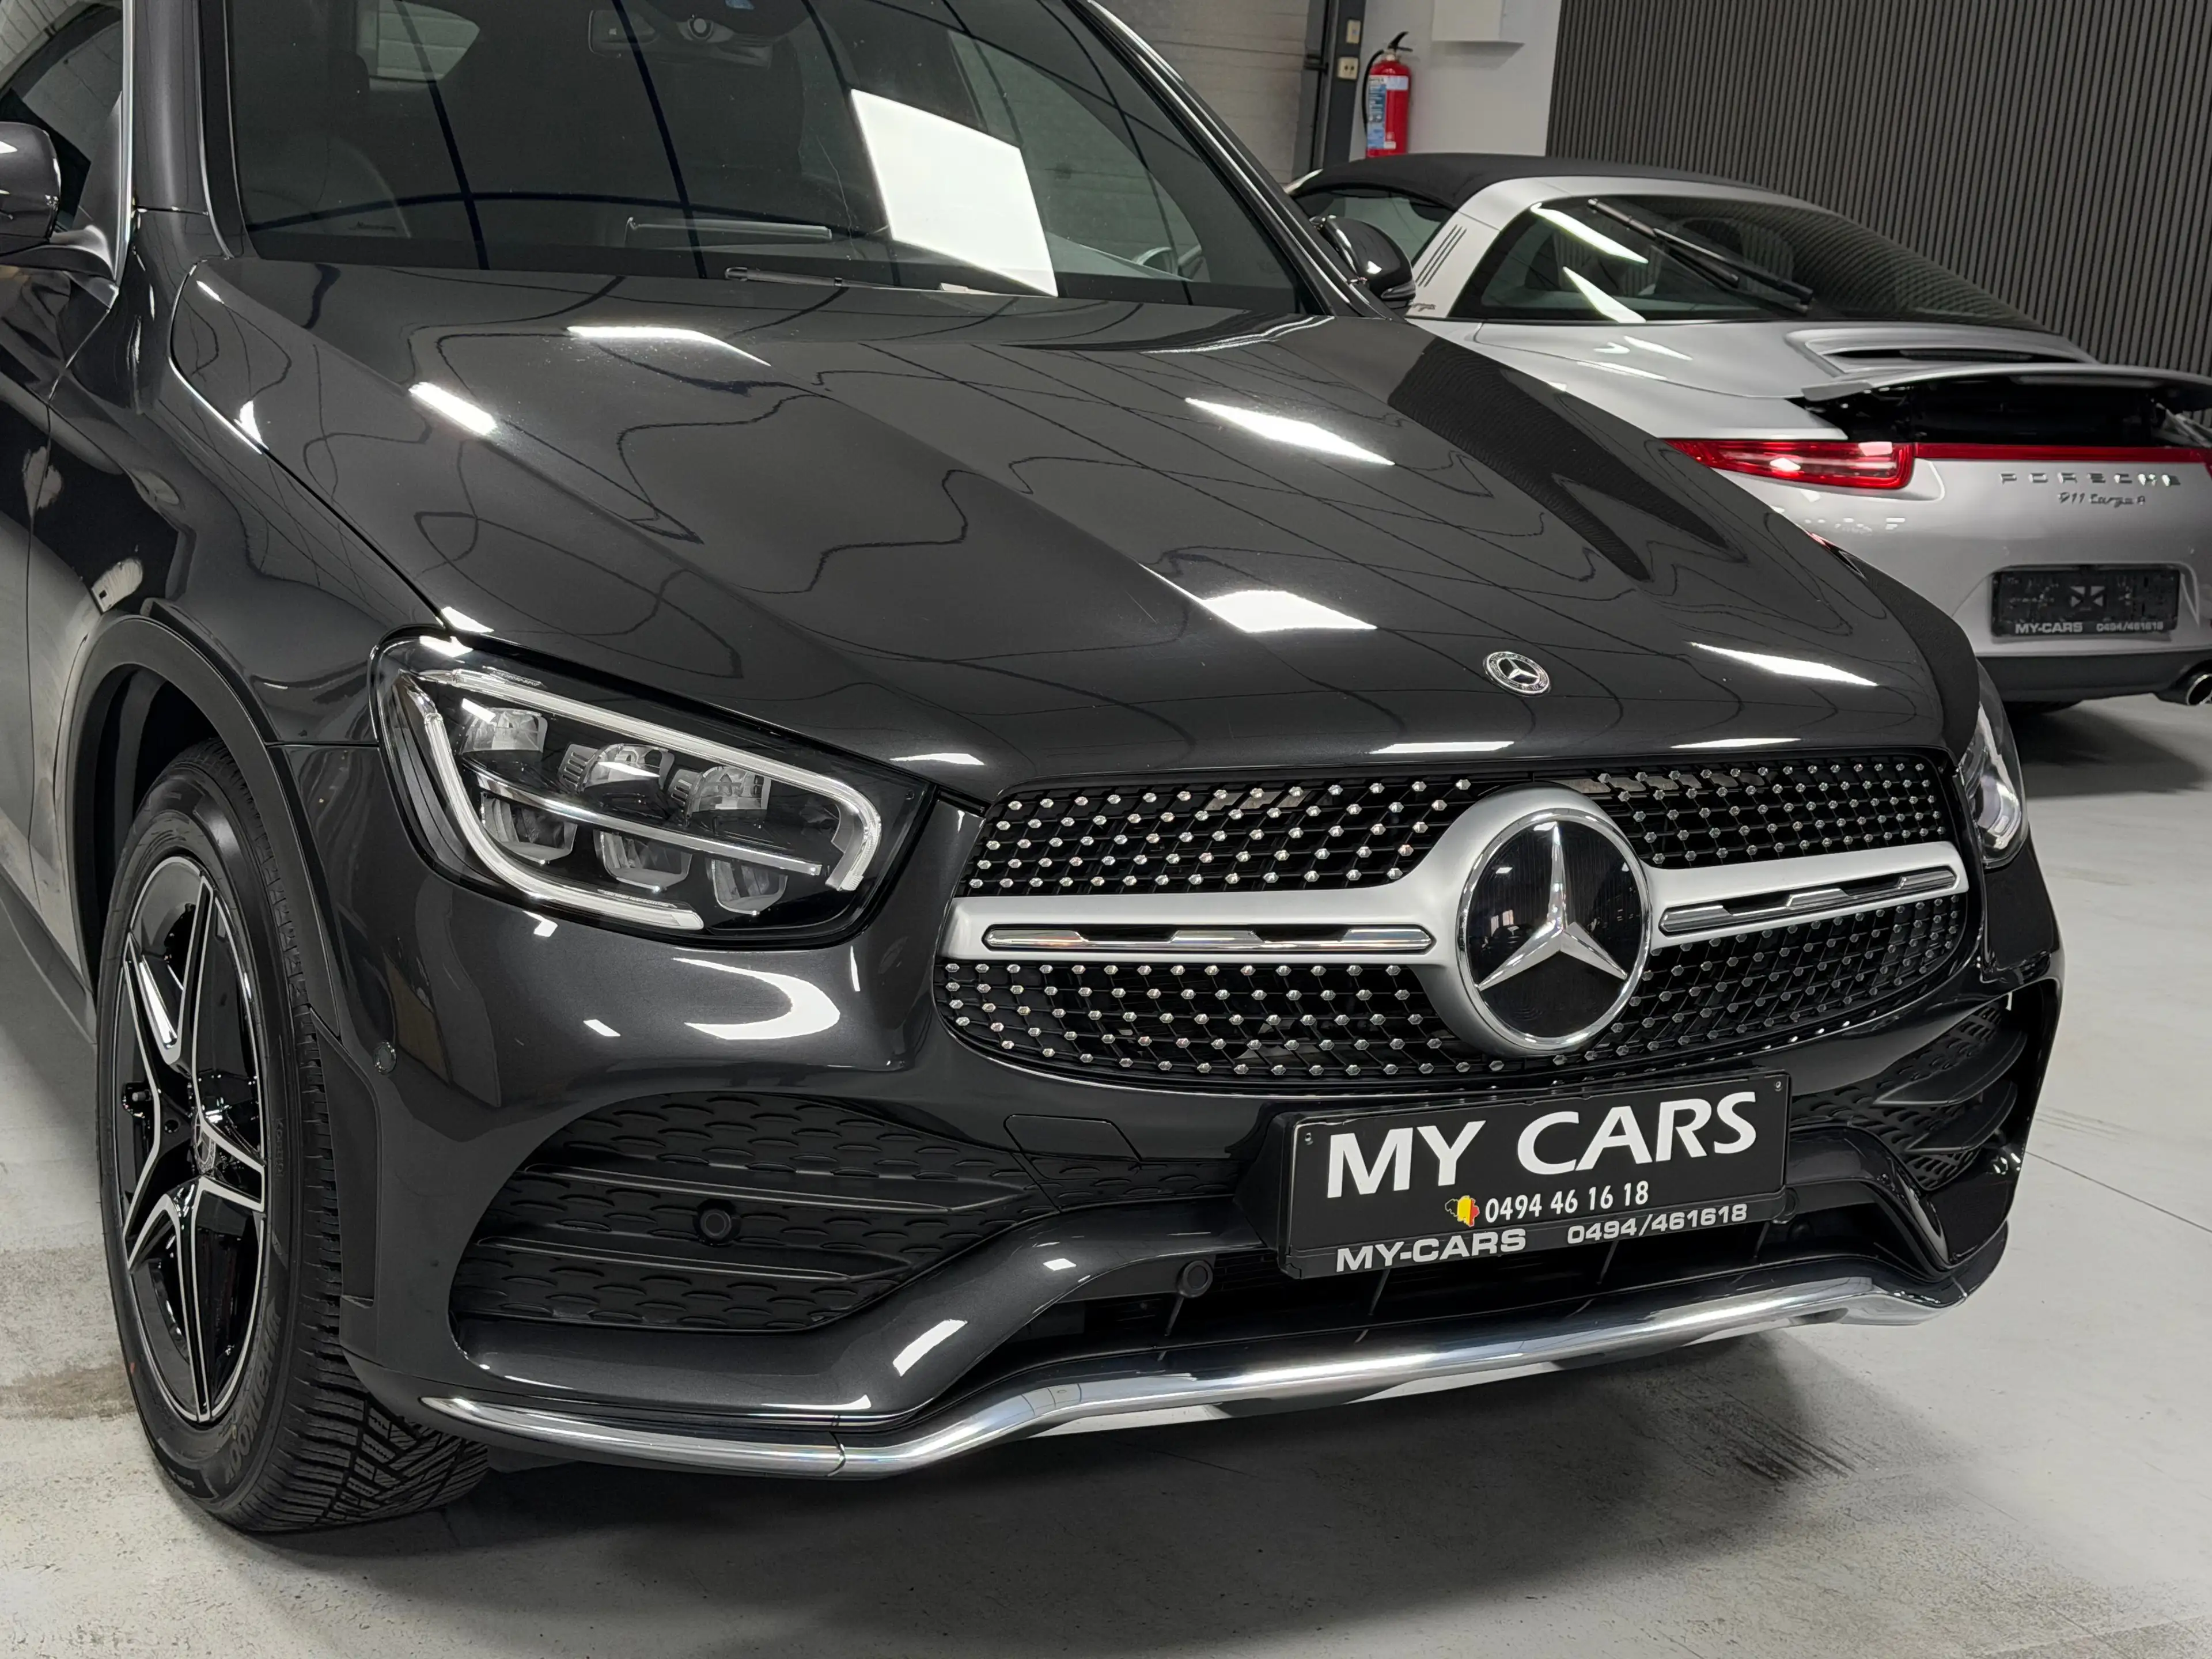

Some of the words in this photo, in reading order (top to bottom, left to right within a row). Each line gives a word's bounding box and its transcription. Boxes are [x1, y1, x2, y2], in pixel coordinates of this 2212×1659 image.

[1999, 472, 2181, 487] PORSCHE
[2057, 492, 2085, 504] 911
[2014, 622, 2084, 634] MY-CARS
[1327, 1120, 1487, 1199] MY
[1517, 1091, 1757, 1175] CARS
[1484, 1193, 1543, 1224] 0494
[1550, 1190, 1578, 1215] 46
[1588, 1185, 1613, 1211] 16
[1623, 1180, 1649, 1207] 18
[1336, 1228, 1527, 1273] MY-CARS
[1567, 1203, 1748, 1245] 0494/461618
